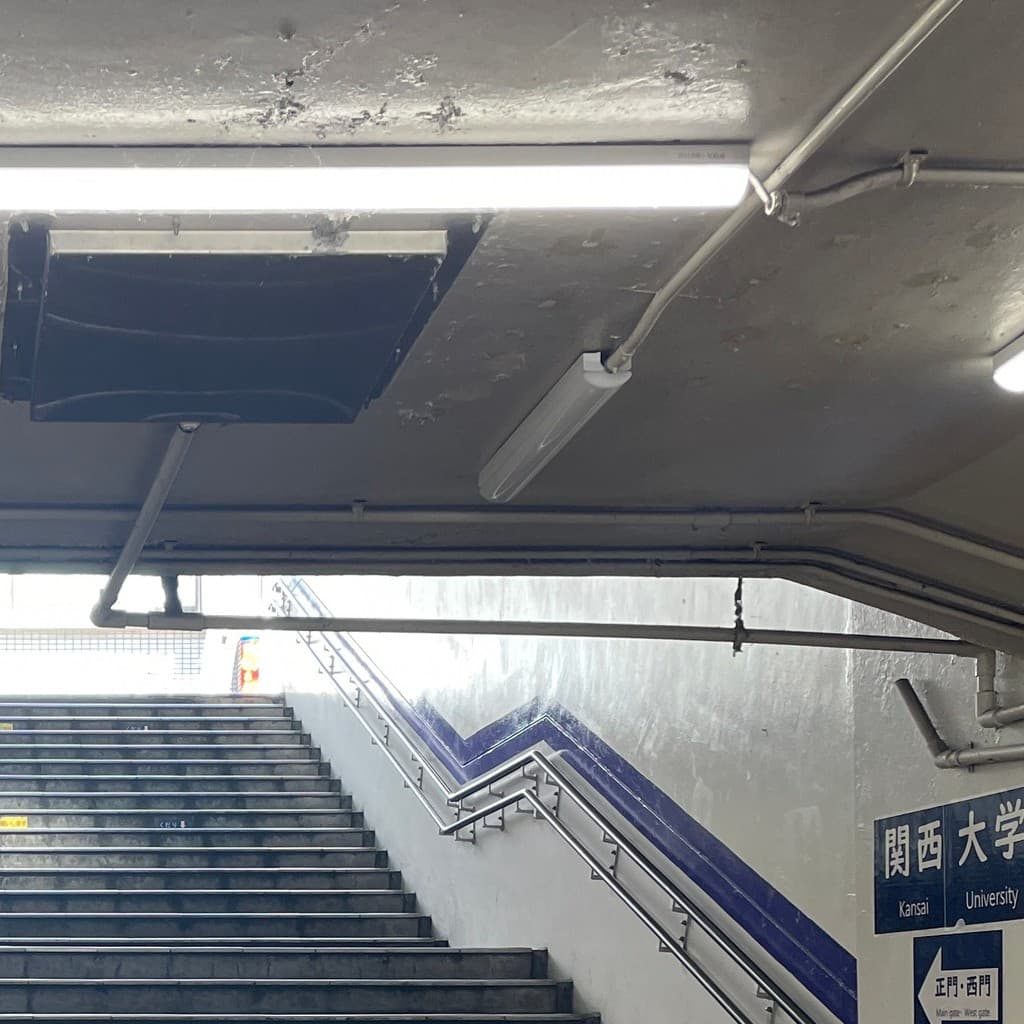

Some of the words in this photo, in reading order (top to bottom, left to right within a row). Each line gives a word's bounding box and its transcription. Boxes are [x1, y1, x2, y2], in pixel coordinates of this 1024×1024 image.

[885, 798, 1024, 880] 関西大学
[899, 897, 929, 918] Kansai
[965, 886, 1019, 910] University
